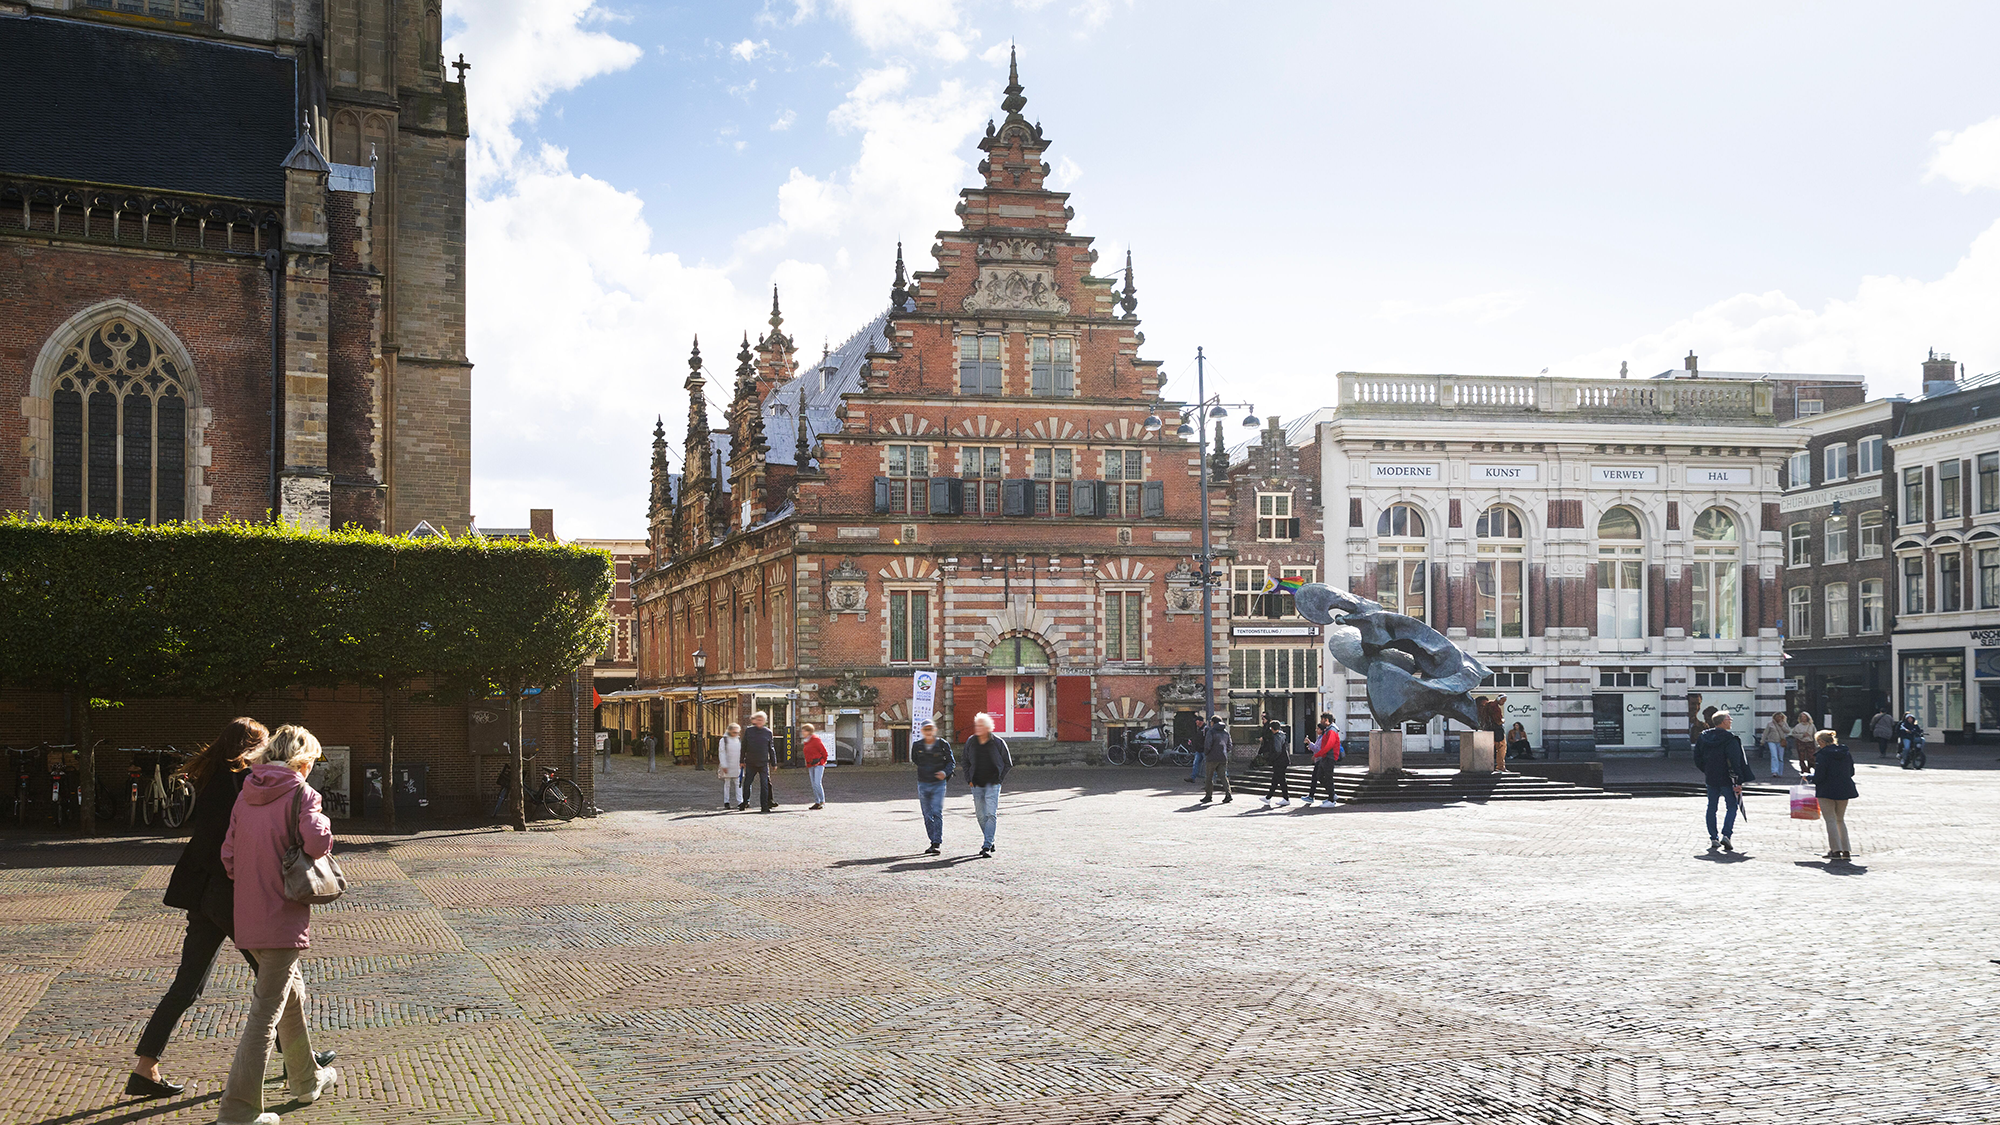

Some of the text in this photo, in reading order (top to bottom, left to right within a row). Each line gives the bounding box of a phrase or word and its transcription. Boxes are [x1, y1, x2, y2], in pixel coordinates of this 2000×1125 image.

[1376, 466, 1729, 481] MODERNE KUNST VERWEY HAL
